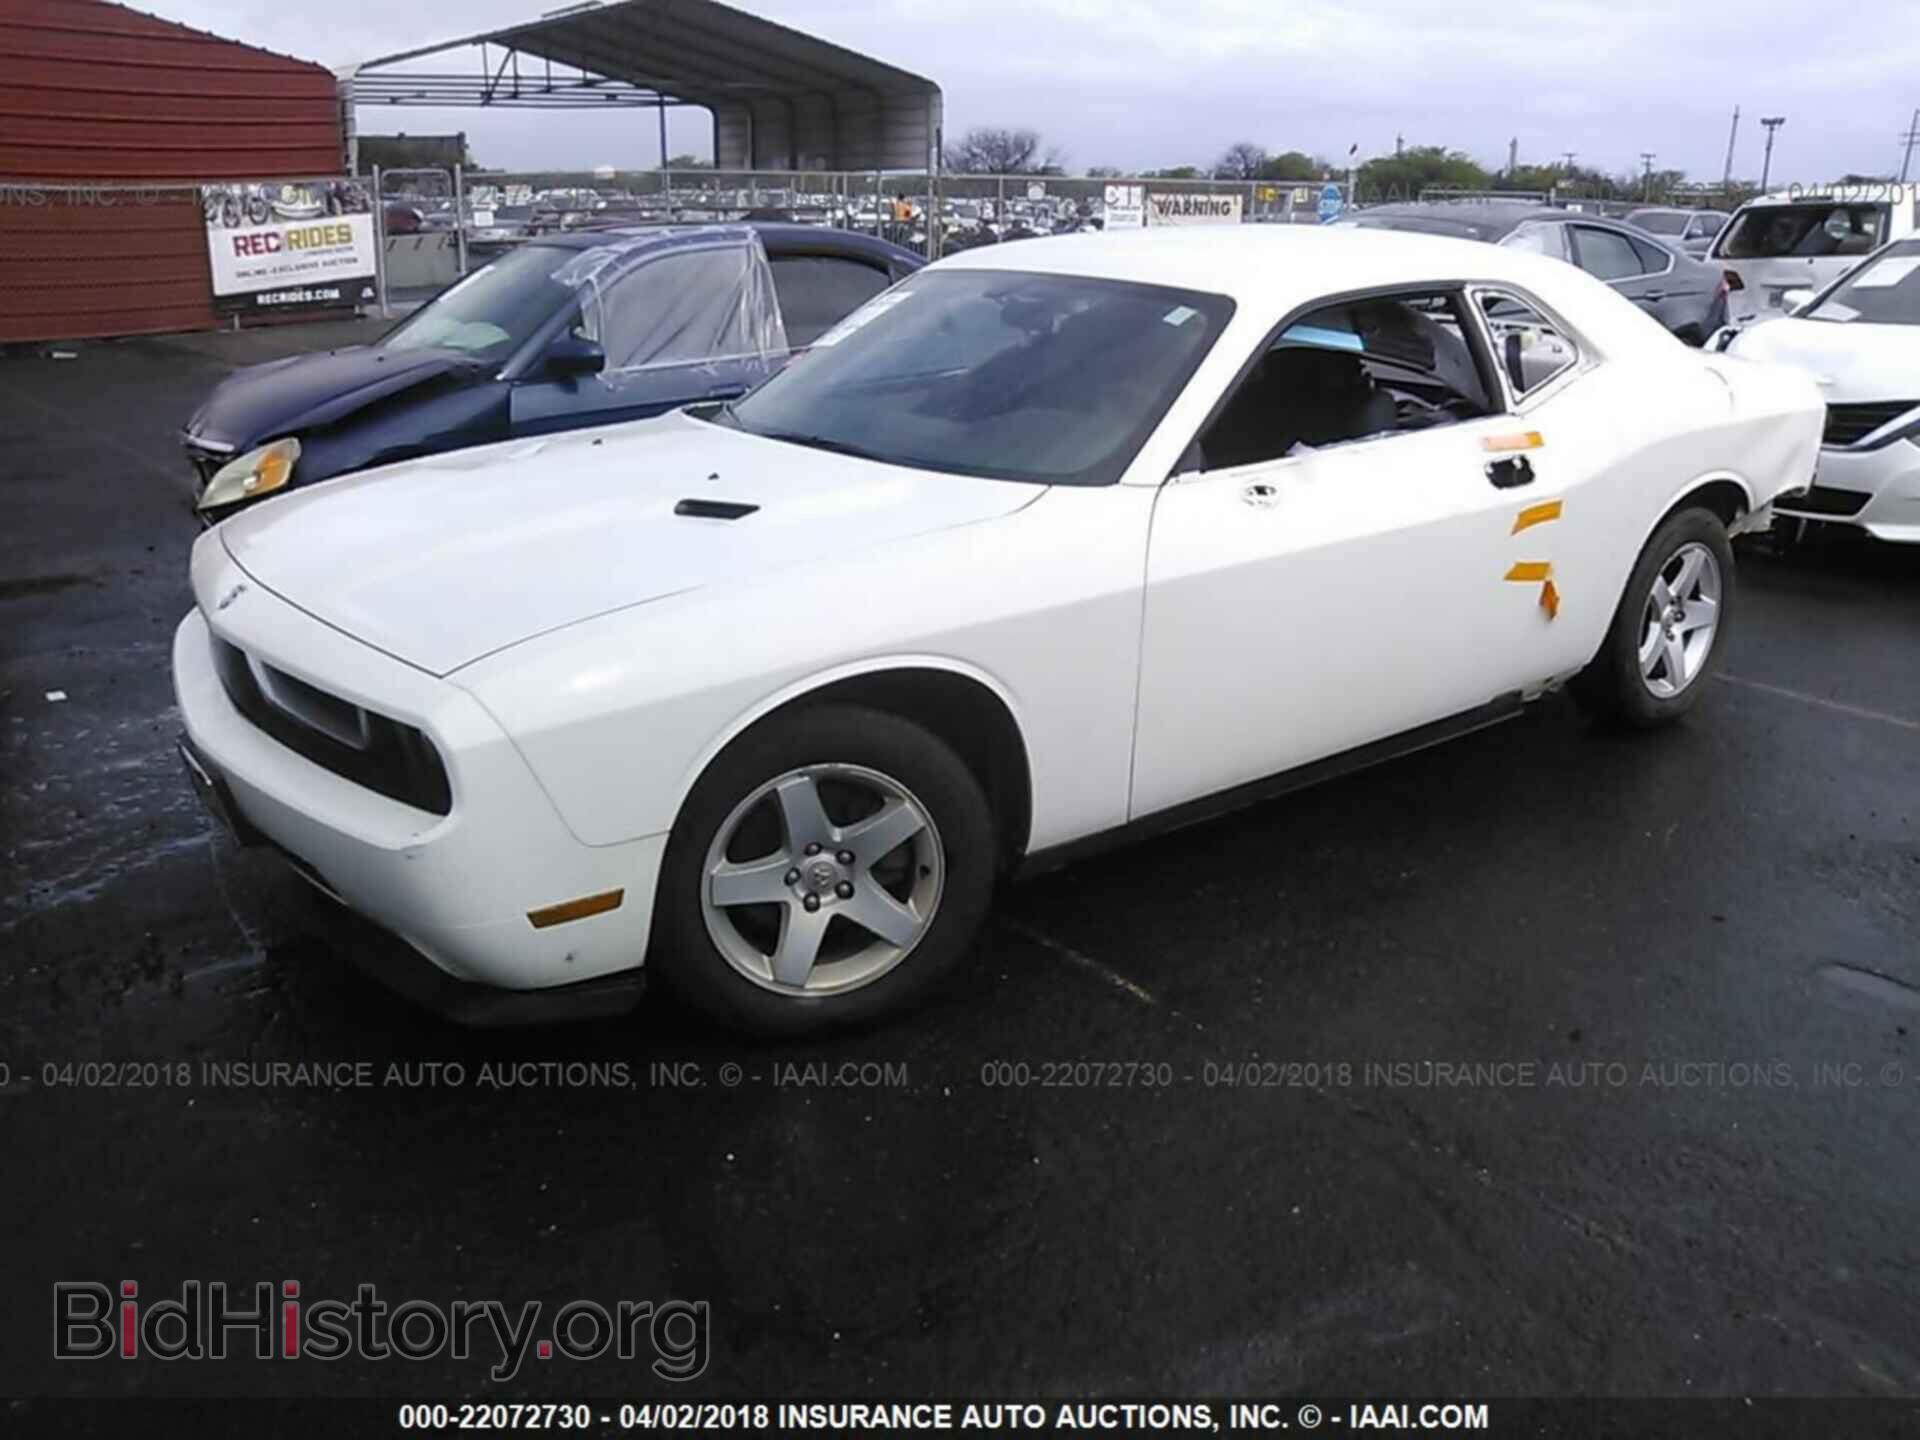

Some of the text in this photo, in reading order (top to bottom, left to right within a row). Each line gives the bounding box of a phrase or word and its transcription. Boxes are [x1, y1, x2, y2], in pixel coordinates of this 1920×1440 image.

[1156, 198, 1231, 218] WARNING
[231, 230, 281, 258] REC
[286, 223, 353, 251] RIDES
